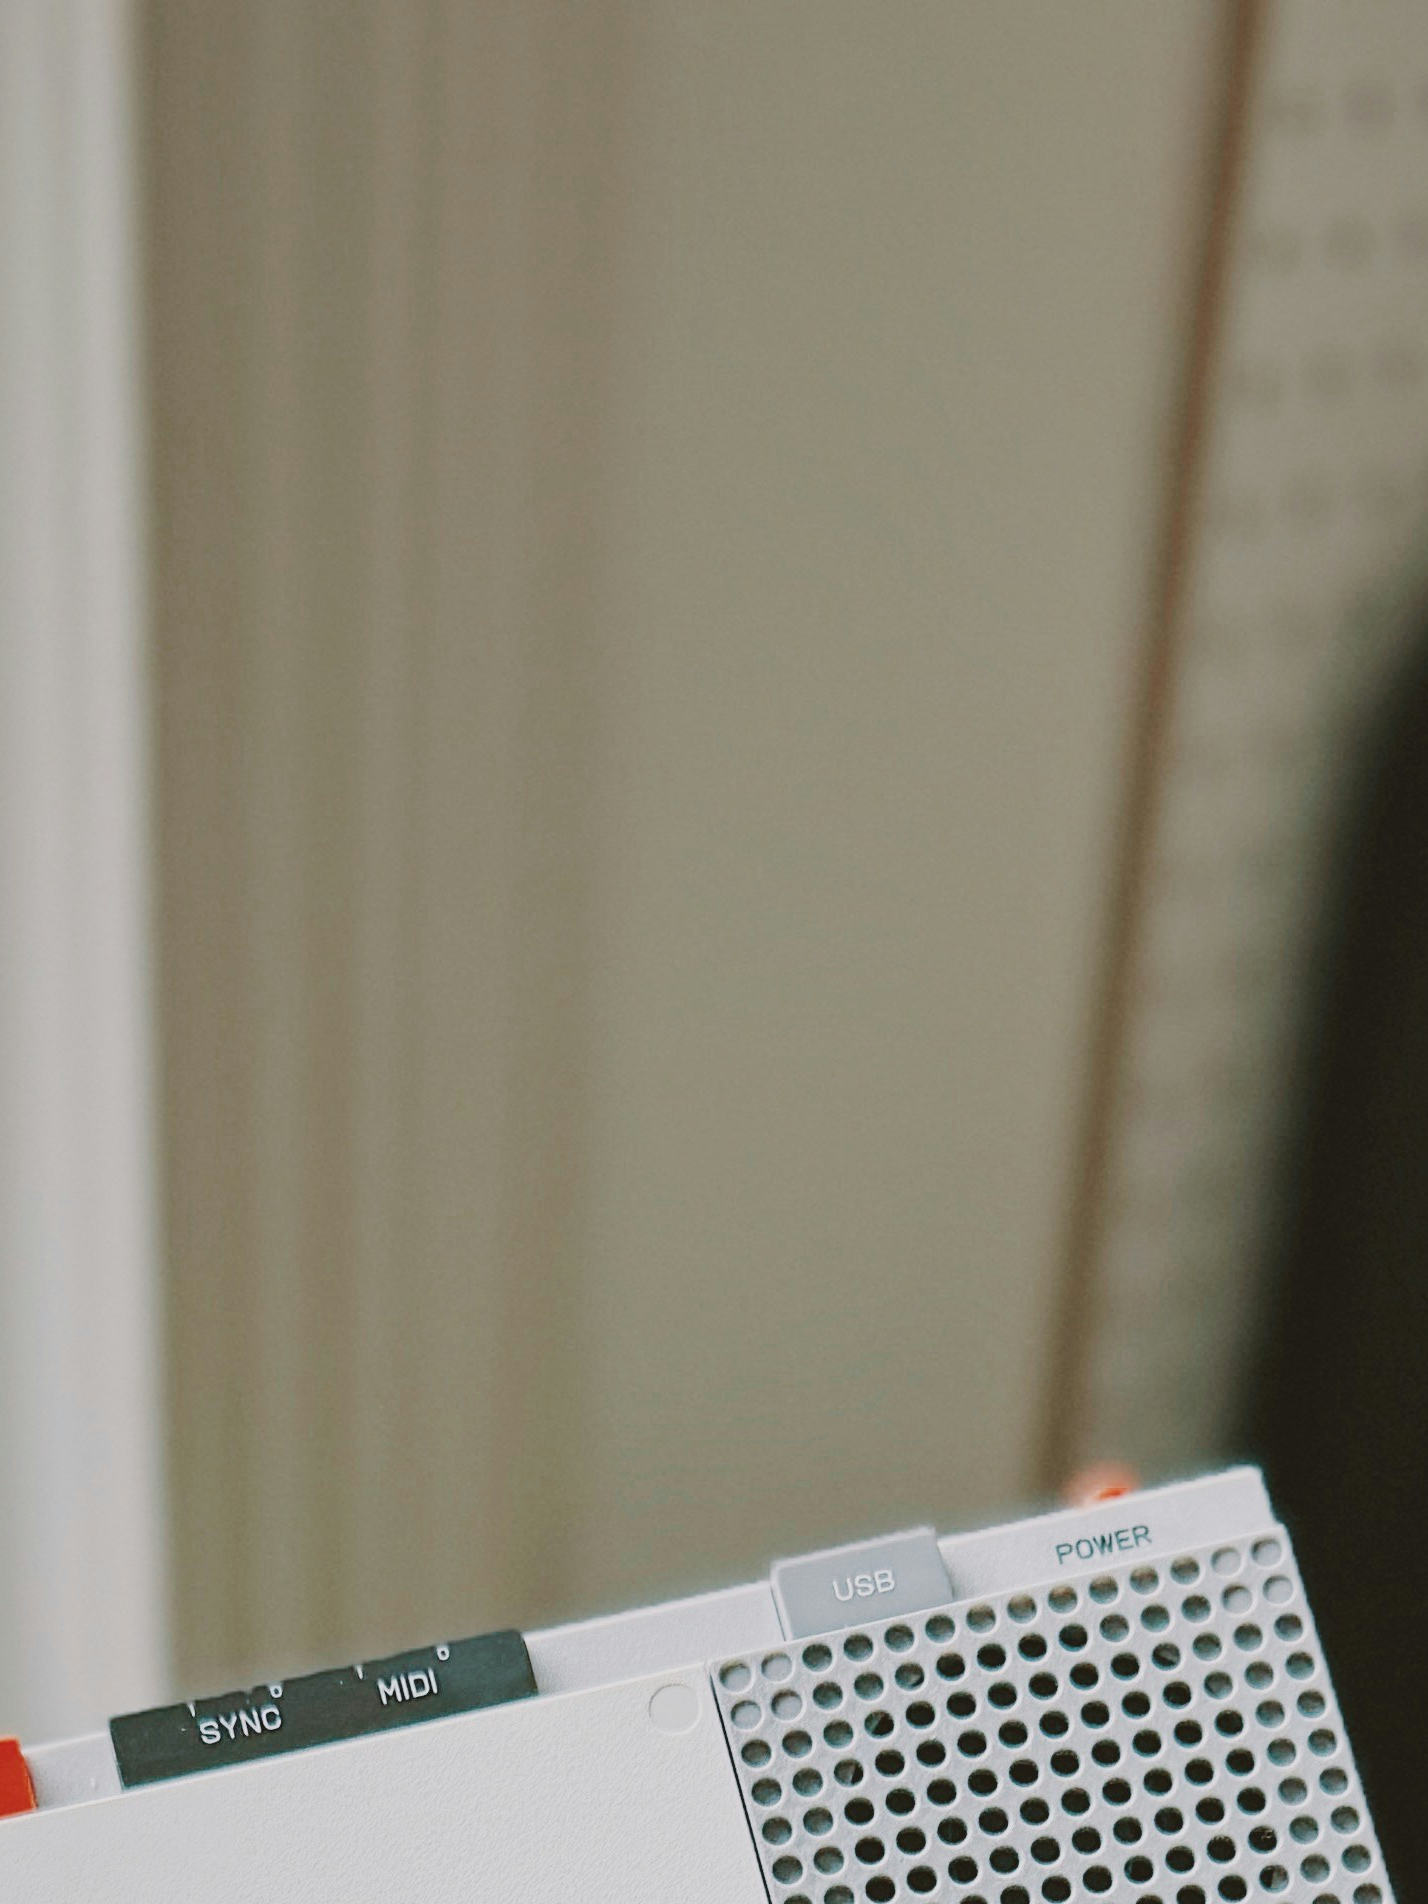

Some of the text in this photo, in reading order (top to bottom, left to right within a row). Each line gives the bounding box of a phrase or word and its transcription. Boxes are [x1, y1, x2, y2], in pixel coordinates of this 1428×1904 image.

[1055, 1524, 1153, 1566] POWER
[831, 1567, 896, 1602] USB
[377, 1667, 438, 1705] MIDI
[199, 1707, 283, 1745] SYNC
